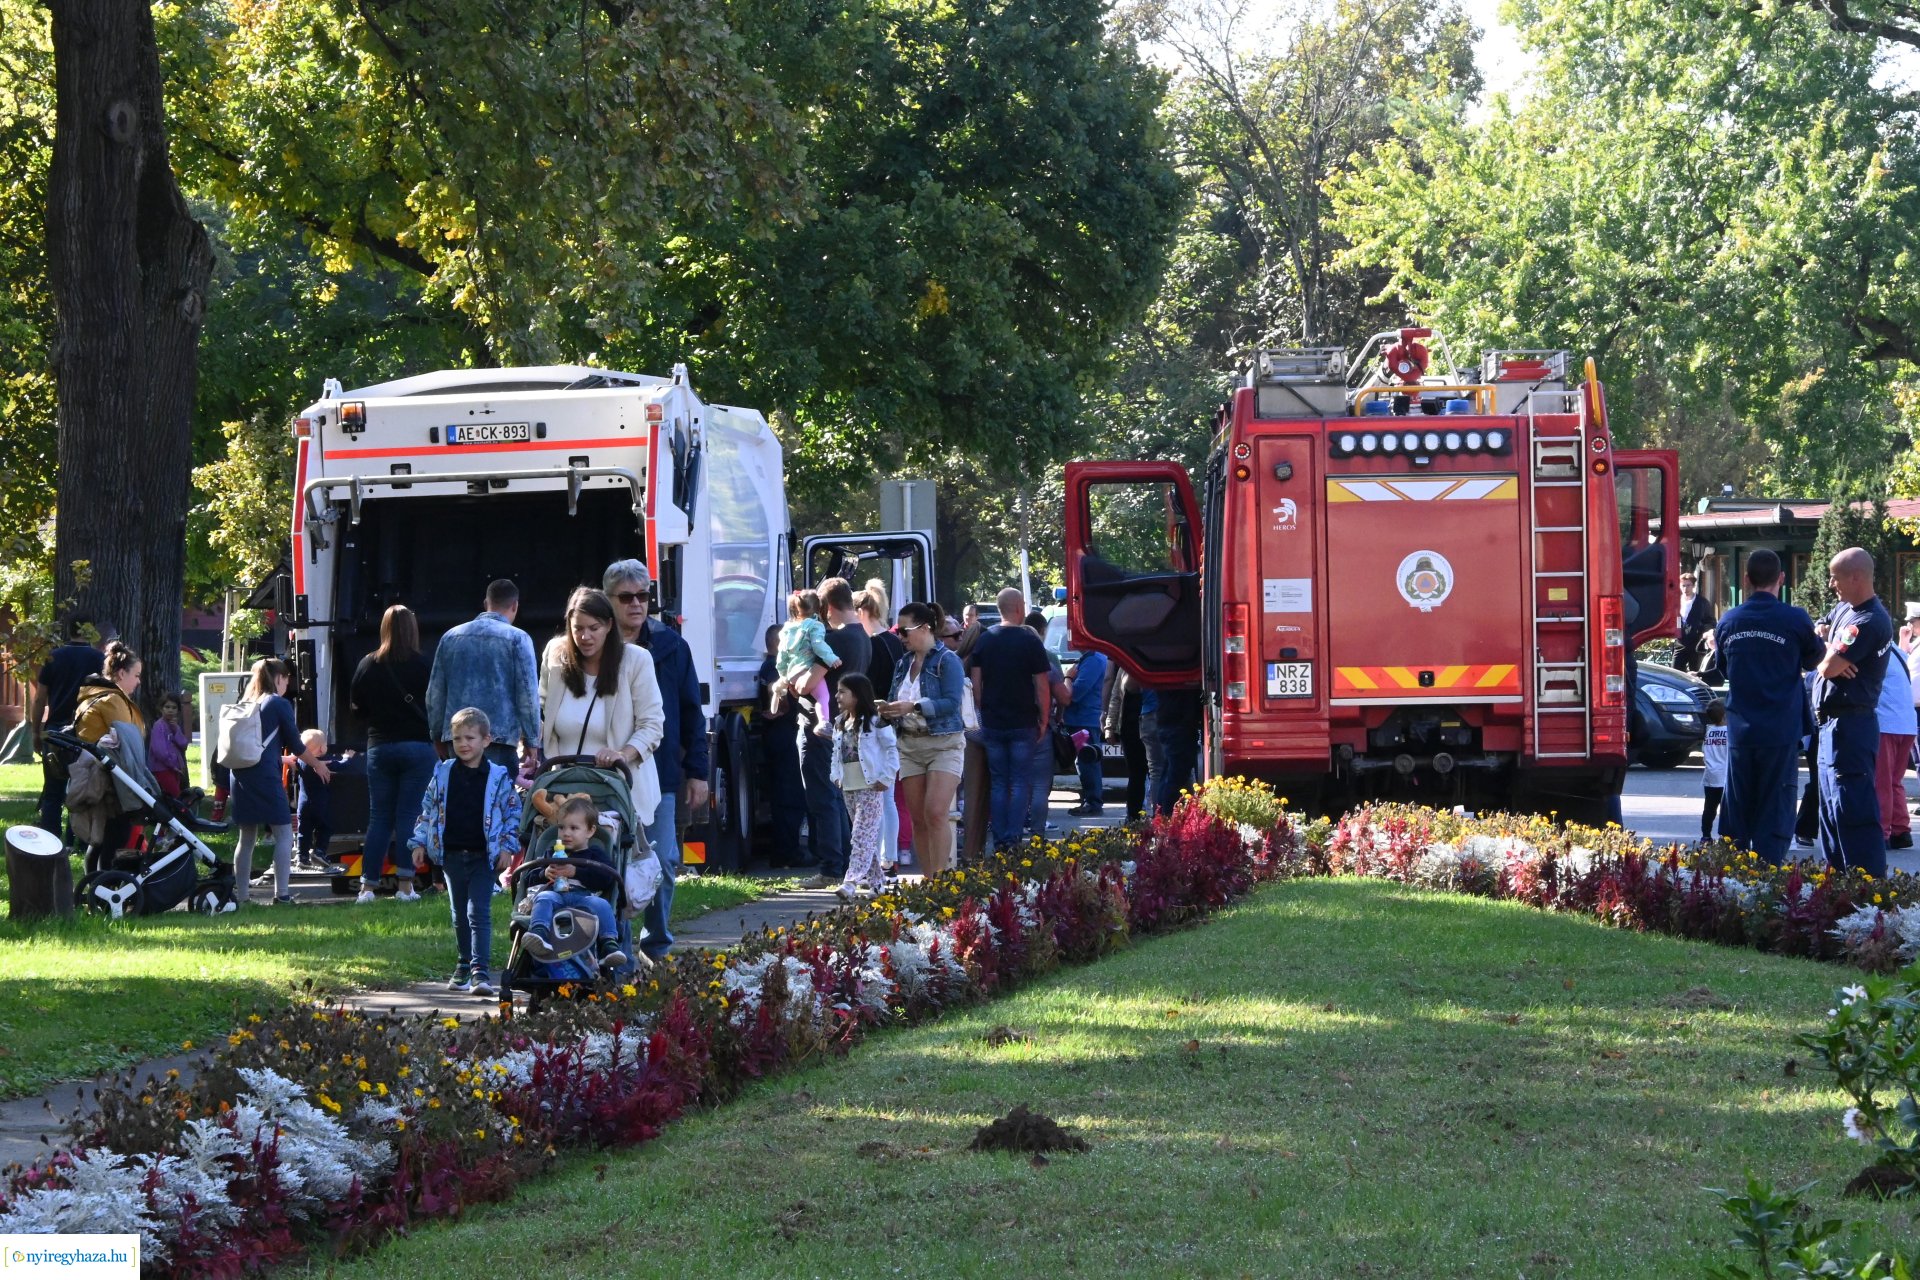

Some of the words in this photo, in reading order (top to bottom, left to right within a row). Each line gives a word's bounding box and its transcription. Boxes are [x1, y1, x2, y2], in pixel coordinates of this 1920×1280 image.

[458, 427, 475, 441] AE
[481, 425, 527, 440] CK-893
[1276, 664, 1310, 679] NRZ
[1279, 679, 1307, 693] 838
